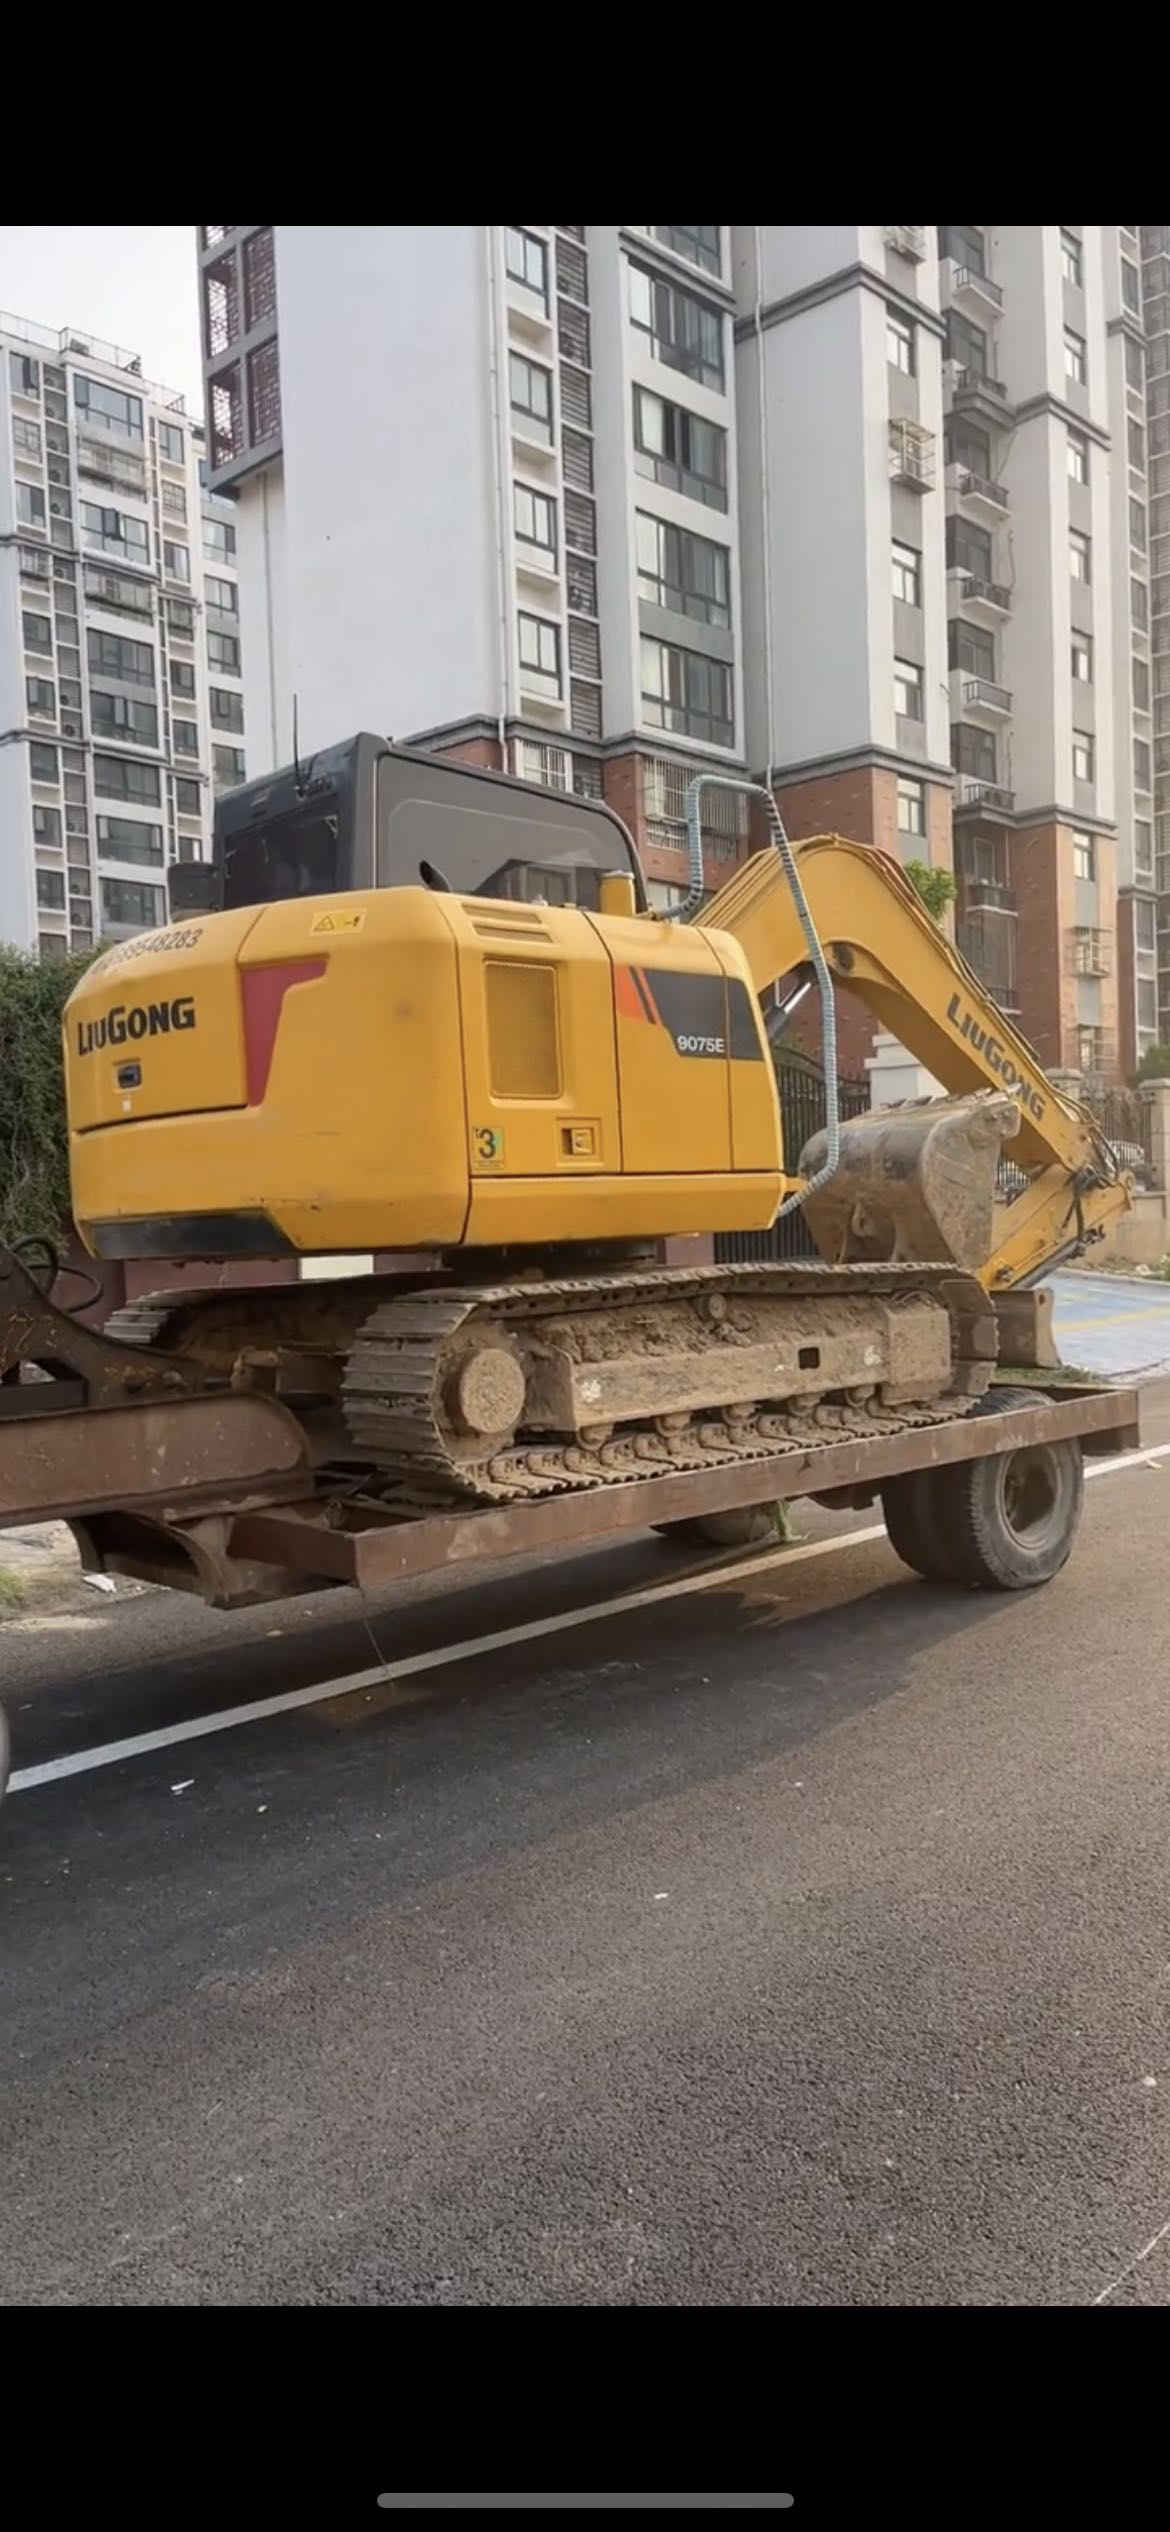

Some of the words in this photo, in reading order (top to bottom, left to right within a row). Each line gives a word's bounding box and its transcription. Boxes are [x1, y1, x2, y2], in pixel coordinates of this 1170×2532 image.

[78, 997, 195, 1056] LIUGONG
[677, 1035, 725, 1053] 9075E
[947, 992, 1046, 1122] LIUGONG
